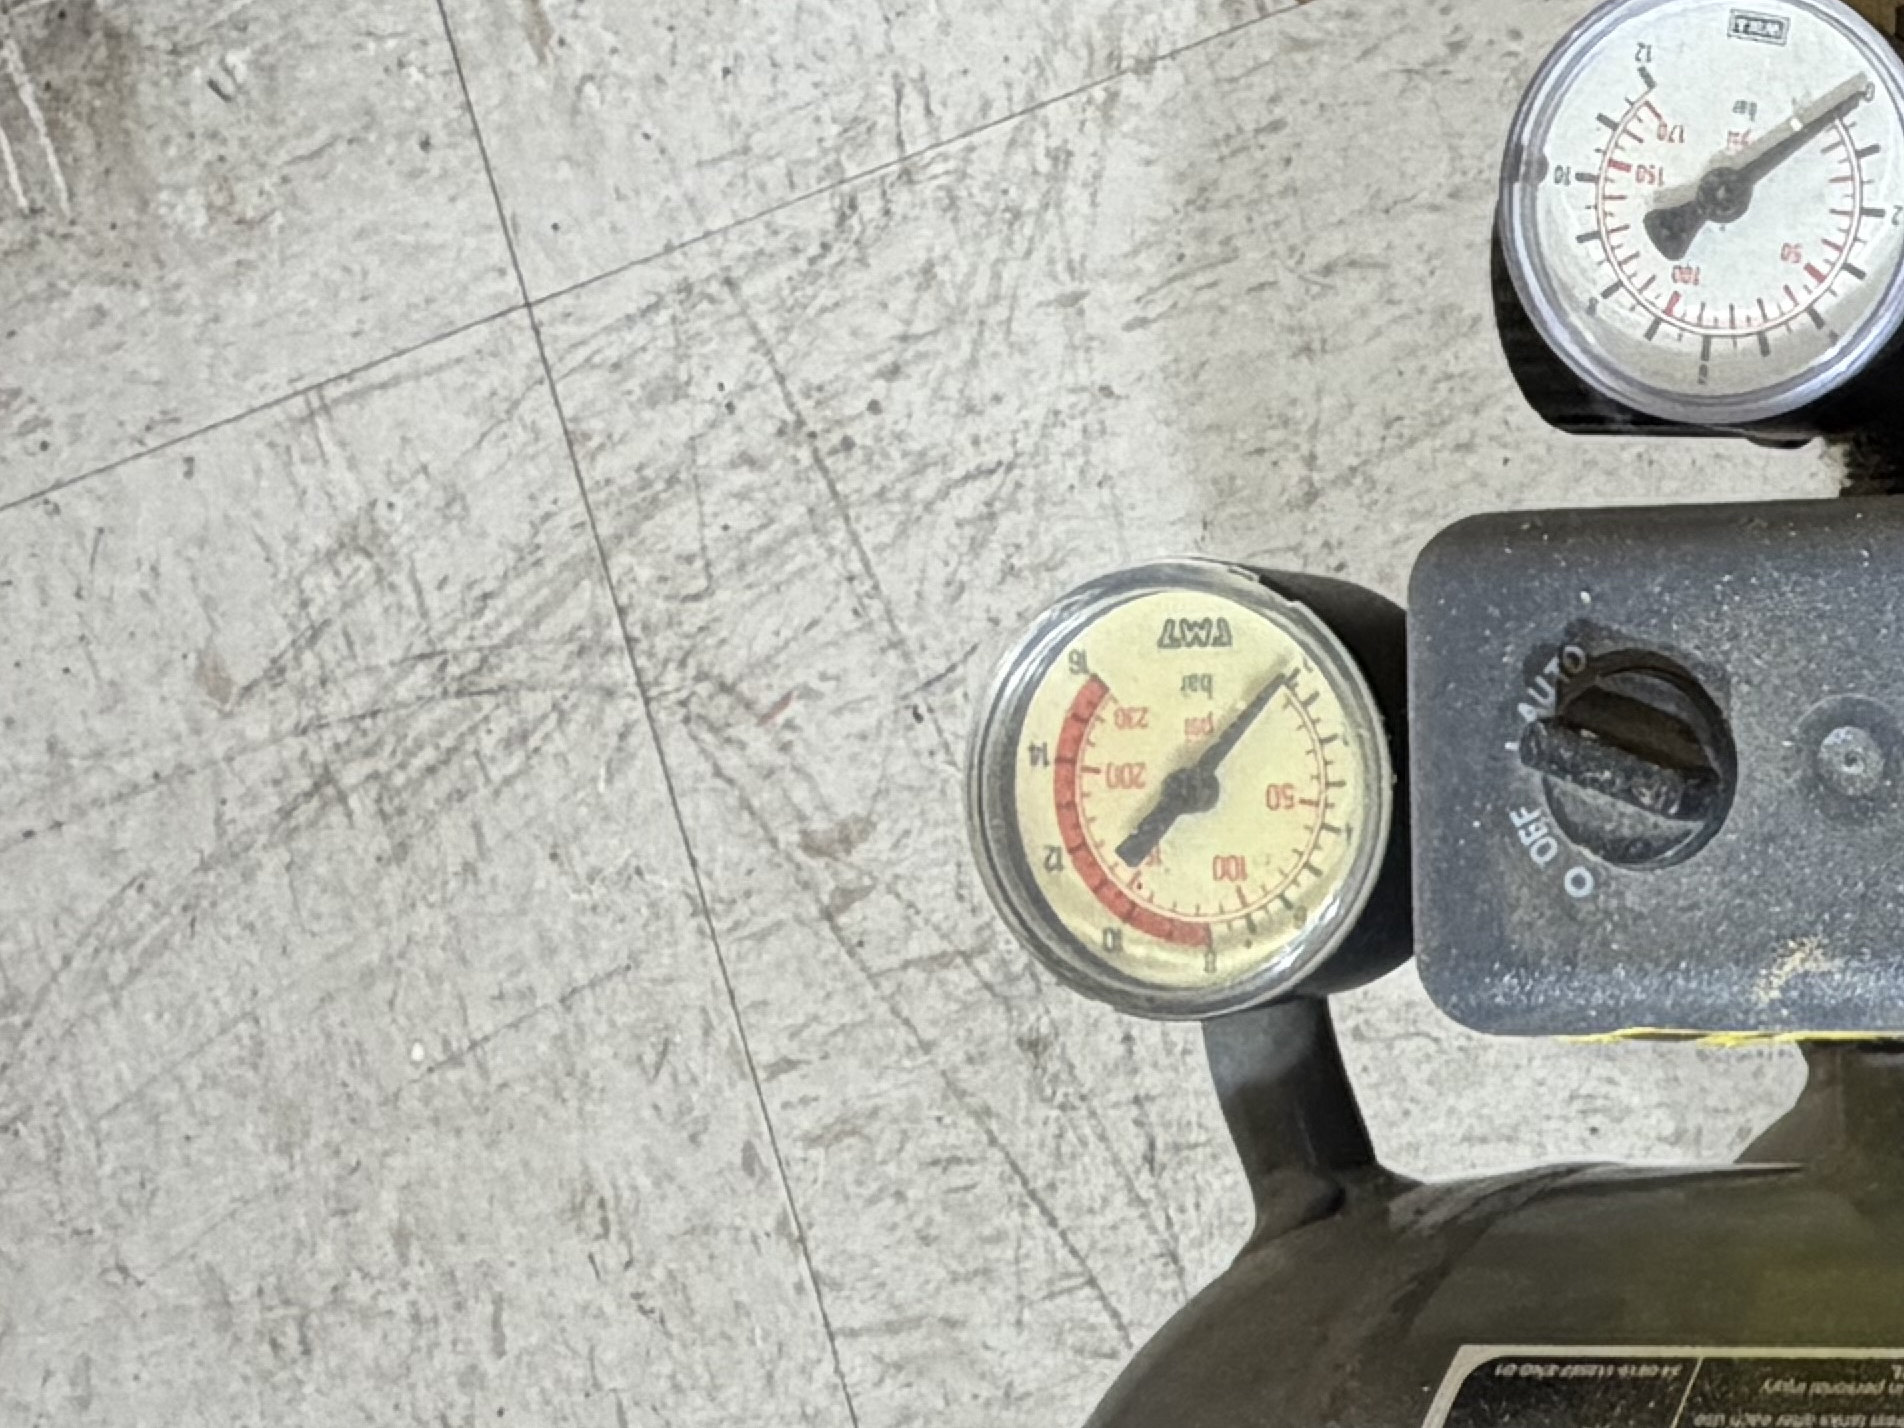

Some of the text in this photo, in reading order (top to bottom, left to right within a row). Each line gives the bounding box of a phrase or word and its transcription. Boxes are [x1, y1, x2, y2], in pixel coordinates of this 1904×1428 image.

[1634, 43, 1652, 62] 12
[1655, 120, 1685, 143] 170
[1553, 166, 1571, 186] 10
[1635, 164, 1664, 187] 150
[1892, 206, 1902, 225] 2
[1780, 243, 1800, 264] 50
[1671, 265, 1699, 286] 100
[1069, 650, 1091, 674] 16
[1180, 674, 1212, 699] bar
[1114, 707, 1148, 729] 230
[1029, 742, 1049, 767] 14
[1106, 762, 1146, 789] 200
[1266, 784, 1295, 811] 50
[1044, 845, 1063, 872] 12
[1213, 855, 1247, 881] 100
[1103, 927, 1121, 952] 10
